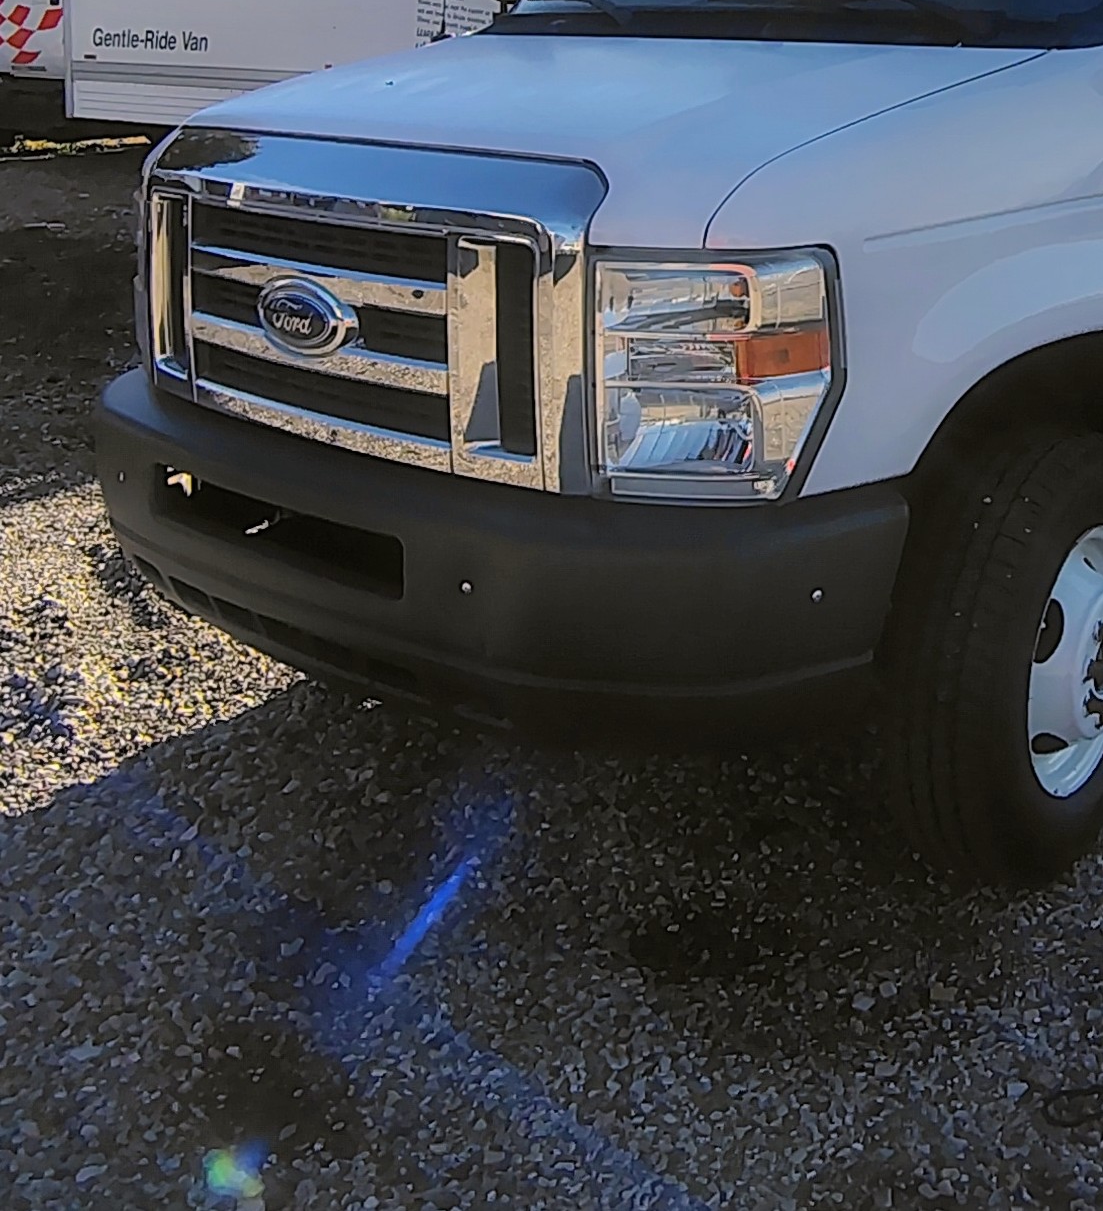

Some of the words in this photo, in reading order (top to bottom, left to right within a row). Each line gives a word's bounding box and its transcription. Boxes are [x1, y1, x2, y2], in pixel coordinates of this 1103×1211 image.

[92, 27, 177, 50] Gentle-Ride
[182, 30, 208, 52] Van
[269, 299, 314, 335] Ford
